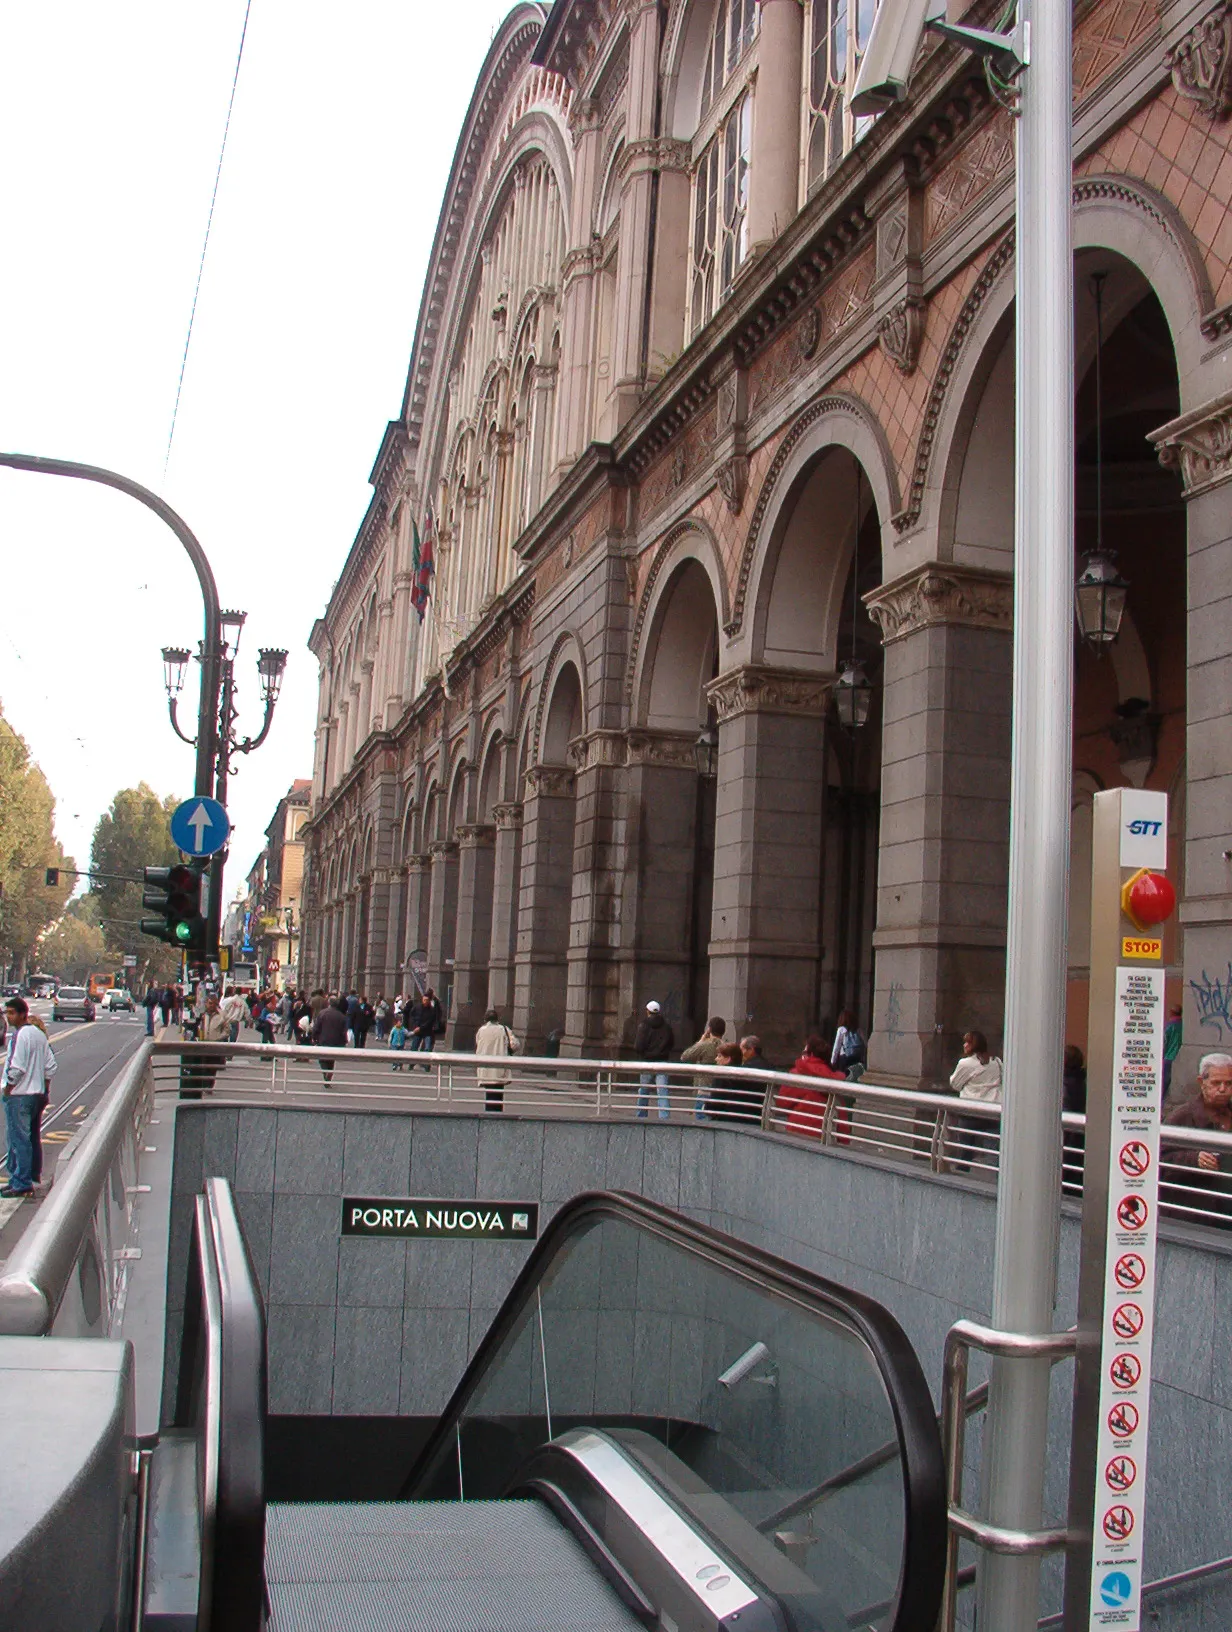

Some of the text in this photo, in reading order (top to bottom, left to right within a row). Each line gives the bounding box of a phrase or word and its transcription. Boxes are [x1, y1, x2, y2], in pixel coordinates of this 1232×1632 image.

[1124, 942, 1159, 953] STOP
[351, 1208, 504, 1230] PORTA NUOVA
